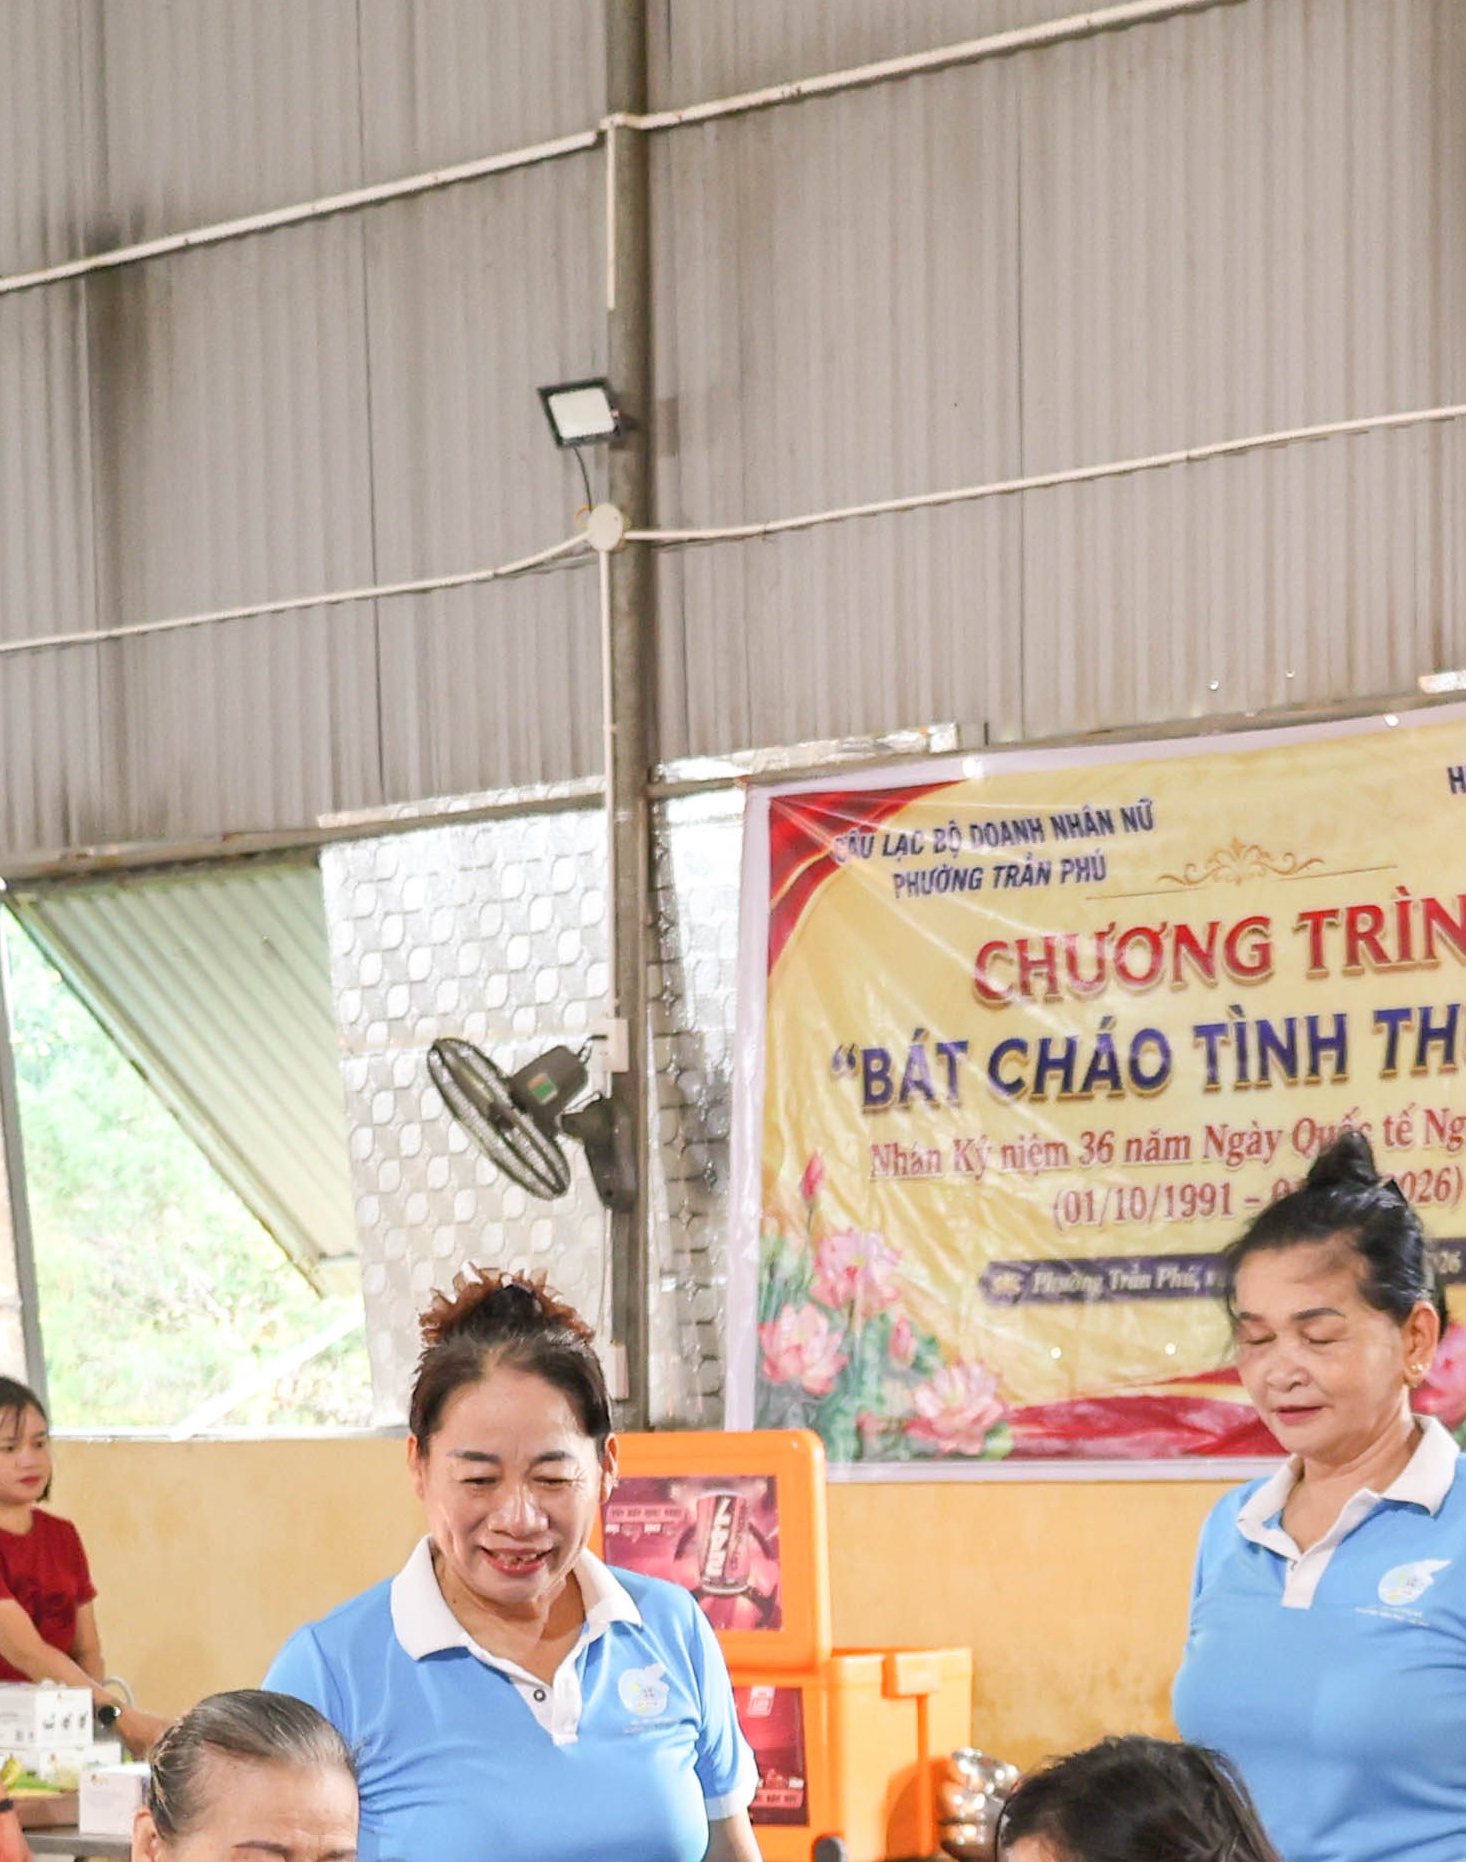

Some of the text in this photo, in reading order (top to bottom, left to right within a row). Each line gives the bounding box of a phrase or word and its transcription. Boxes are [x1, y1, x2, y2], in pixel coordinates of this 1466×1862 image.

[882, 829, 925, 862] LẠC
[933, 819, 962, 859] BỘ
[969, 815, 1046, 850] DOANH
[1050, 804, 1115, 841] NHÂN
[1120, 798, 1154, 834] NỮ
[892, 848, 1107, 899] PHƯỜNG TRẦN PHÚ
[974, 915, 1275, 1005] CHƯƠNG
[987, 1015, 1171, 1104] CHÁO
[1192, 1004, 1349, 1089] TÌNH
[1000, 1133, 1071, 1177] niệm
[1078, 1129, 1115, 1166] 36
[1122, 1127, 1192, 1165] năm
[1202, 1120, 1284, 1168] Ngày
[1383, 1101, 1417, 1148] tế
[1053, 1181, 1235, 1232] (01/10/1991
